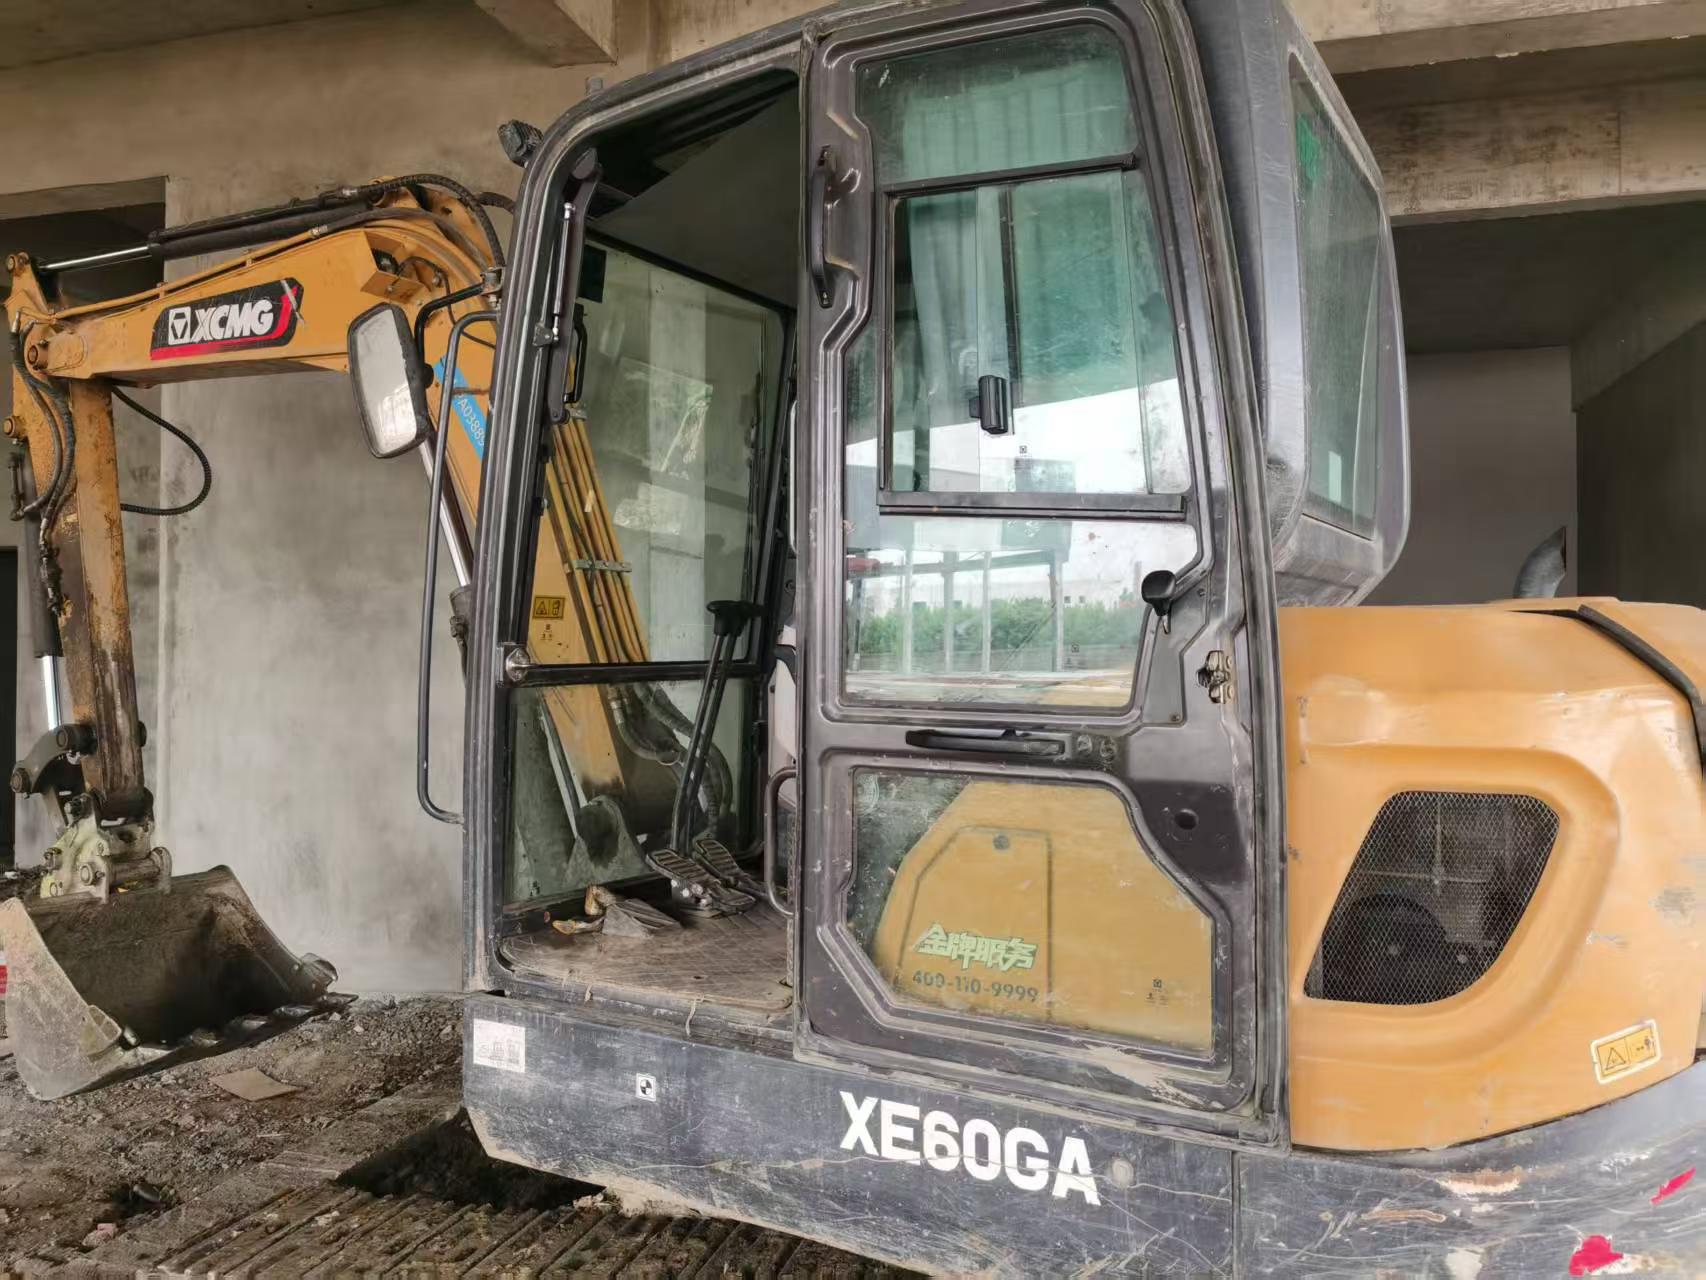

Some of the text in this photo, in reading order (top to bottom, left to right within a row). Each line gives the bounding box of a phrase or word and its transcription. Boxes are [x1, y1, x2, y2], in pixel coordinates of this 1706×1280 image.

[191, 299, 274, 343] XCMG
[912, 922, 1039, 972] 金牌服务
[912, 970, 1039, 1003] 400-110-9999
[840, 1091, 1101, 1206] XE60GA
